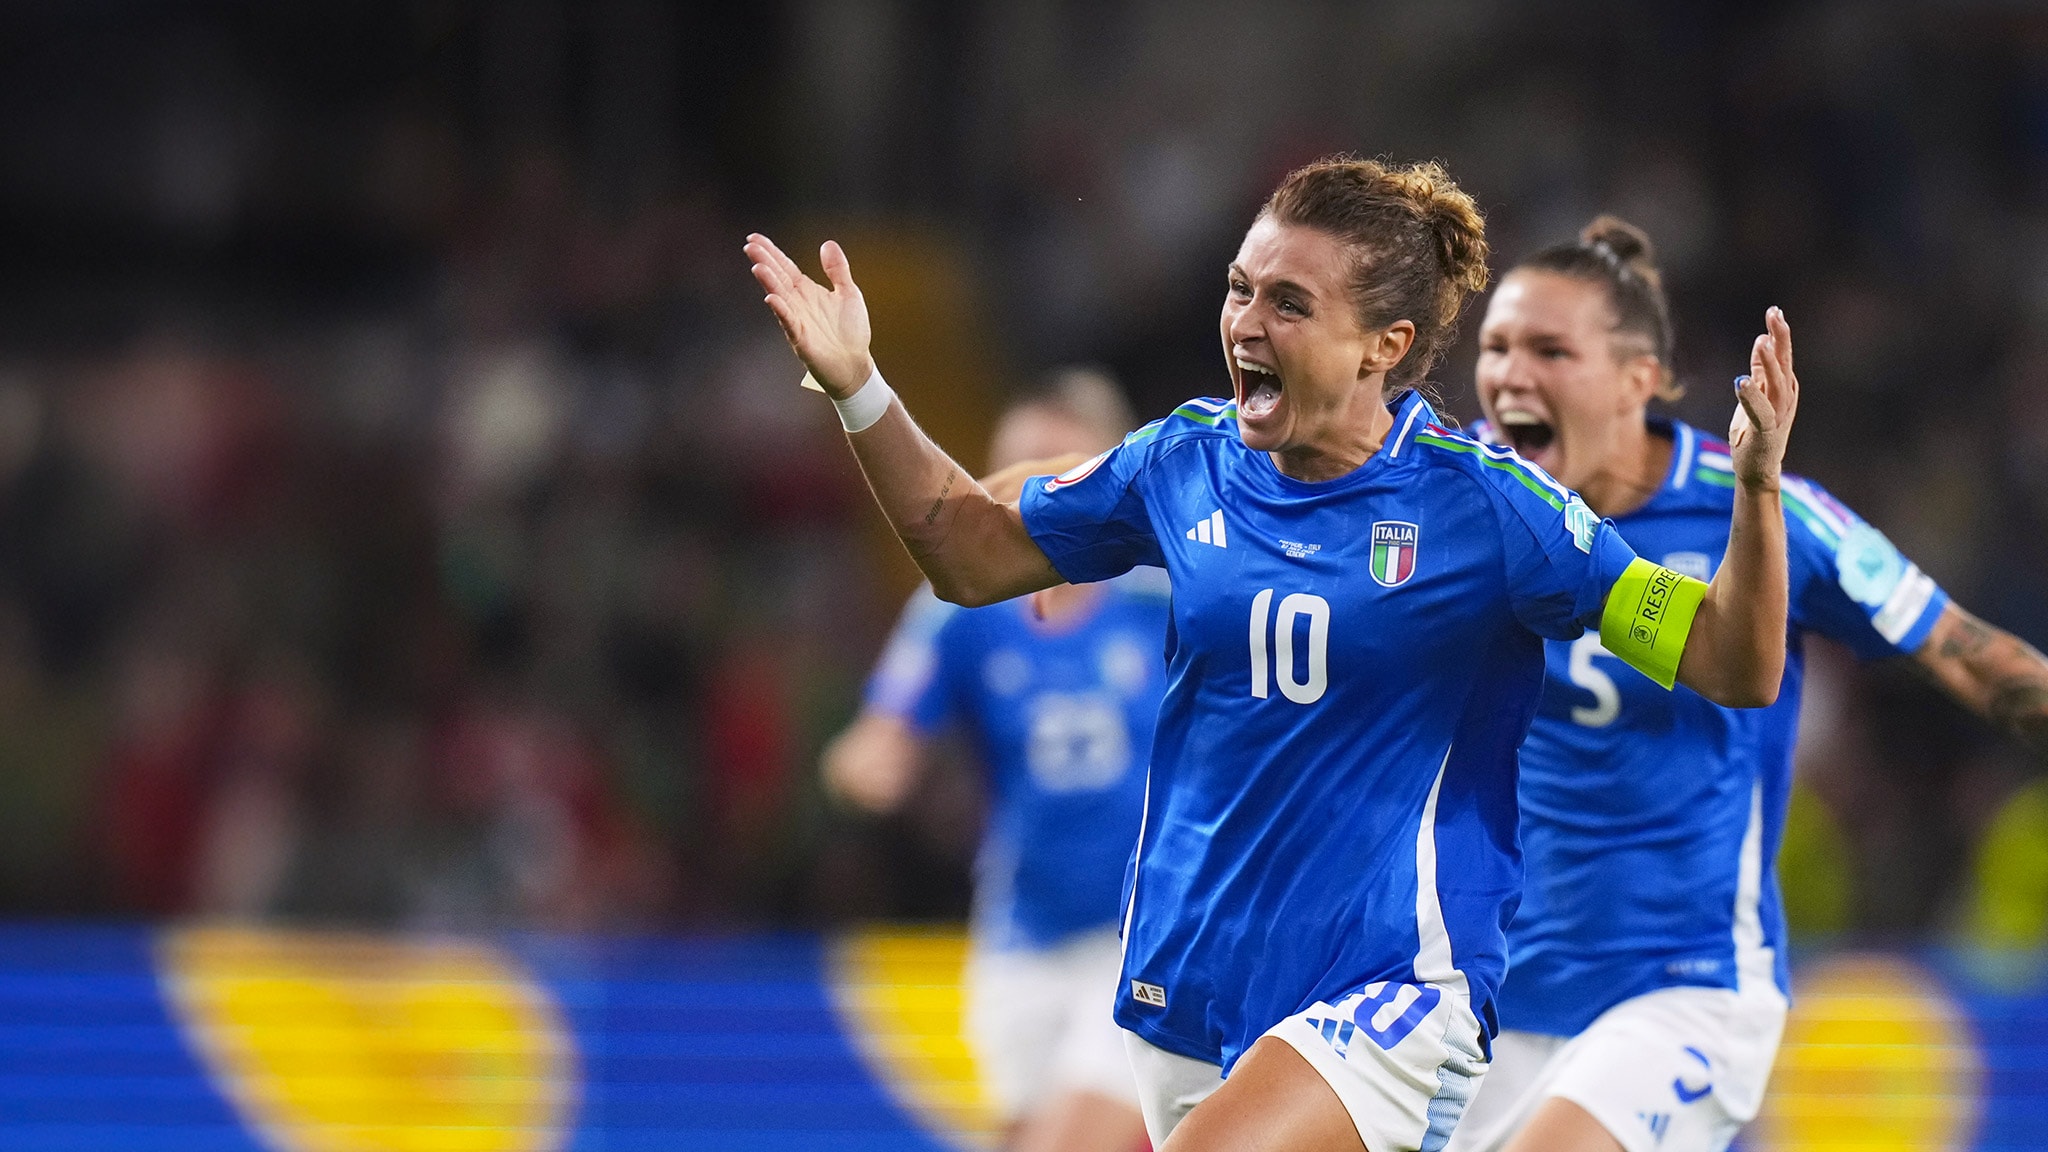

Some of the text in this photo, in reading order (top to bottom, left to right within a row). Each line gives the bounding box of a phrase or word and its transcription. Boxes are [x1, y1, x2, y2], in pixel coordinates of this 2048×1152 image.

[1375, 526, 1413, 541] ITALIA
[1249, 588, 1330, 704] 10
[1569, 632, 1621, 728] 5
